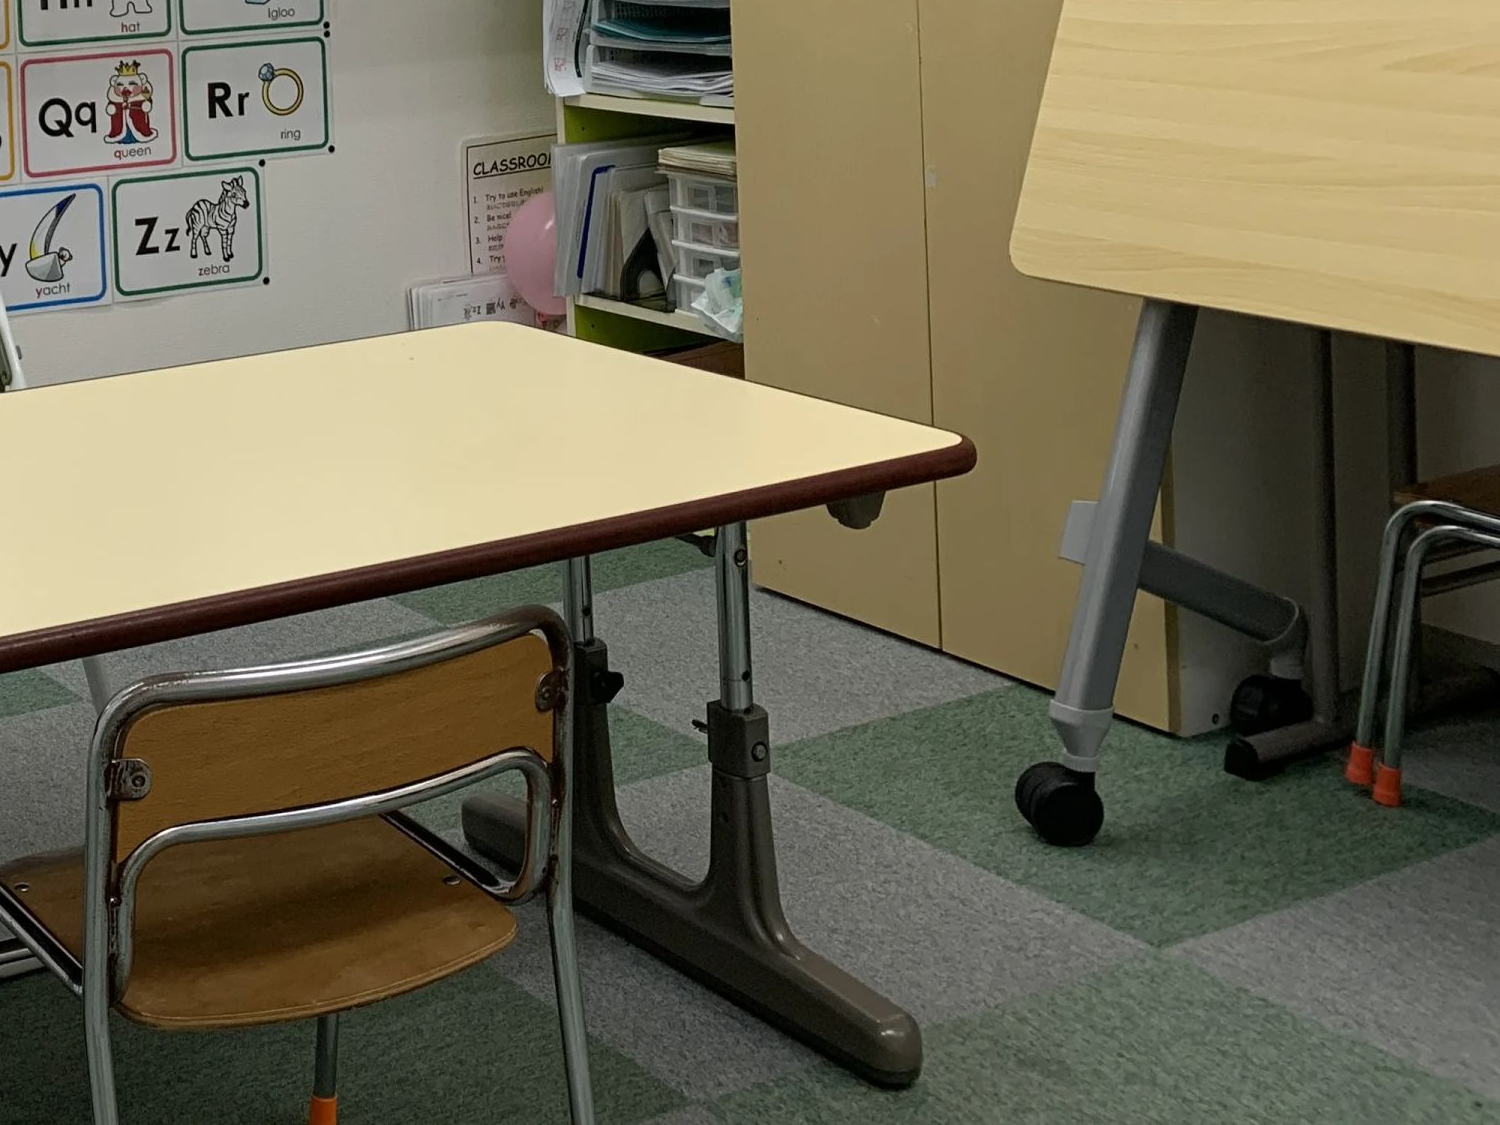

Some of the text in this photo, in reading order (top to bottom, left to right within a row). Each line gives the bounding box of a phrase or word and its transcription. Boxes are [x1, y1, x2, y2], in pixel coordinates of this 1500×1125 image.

[120, 20, 142, 34] hat
[206, 81, 251, 120] Rr
[37, 96, 98, 140] Qq
[279, 127, 302, 143] ring
[113, 145, 153, 162] queen
[473, 152, 551, 176] CLASSROO
[486, 194, 496, 203] Try
[133, 216, 182, 257] Zz
[197, 261, 231, 277] zebra
[35, 281, 71, 300] yacht
